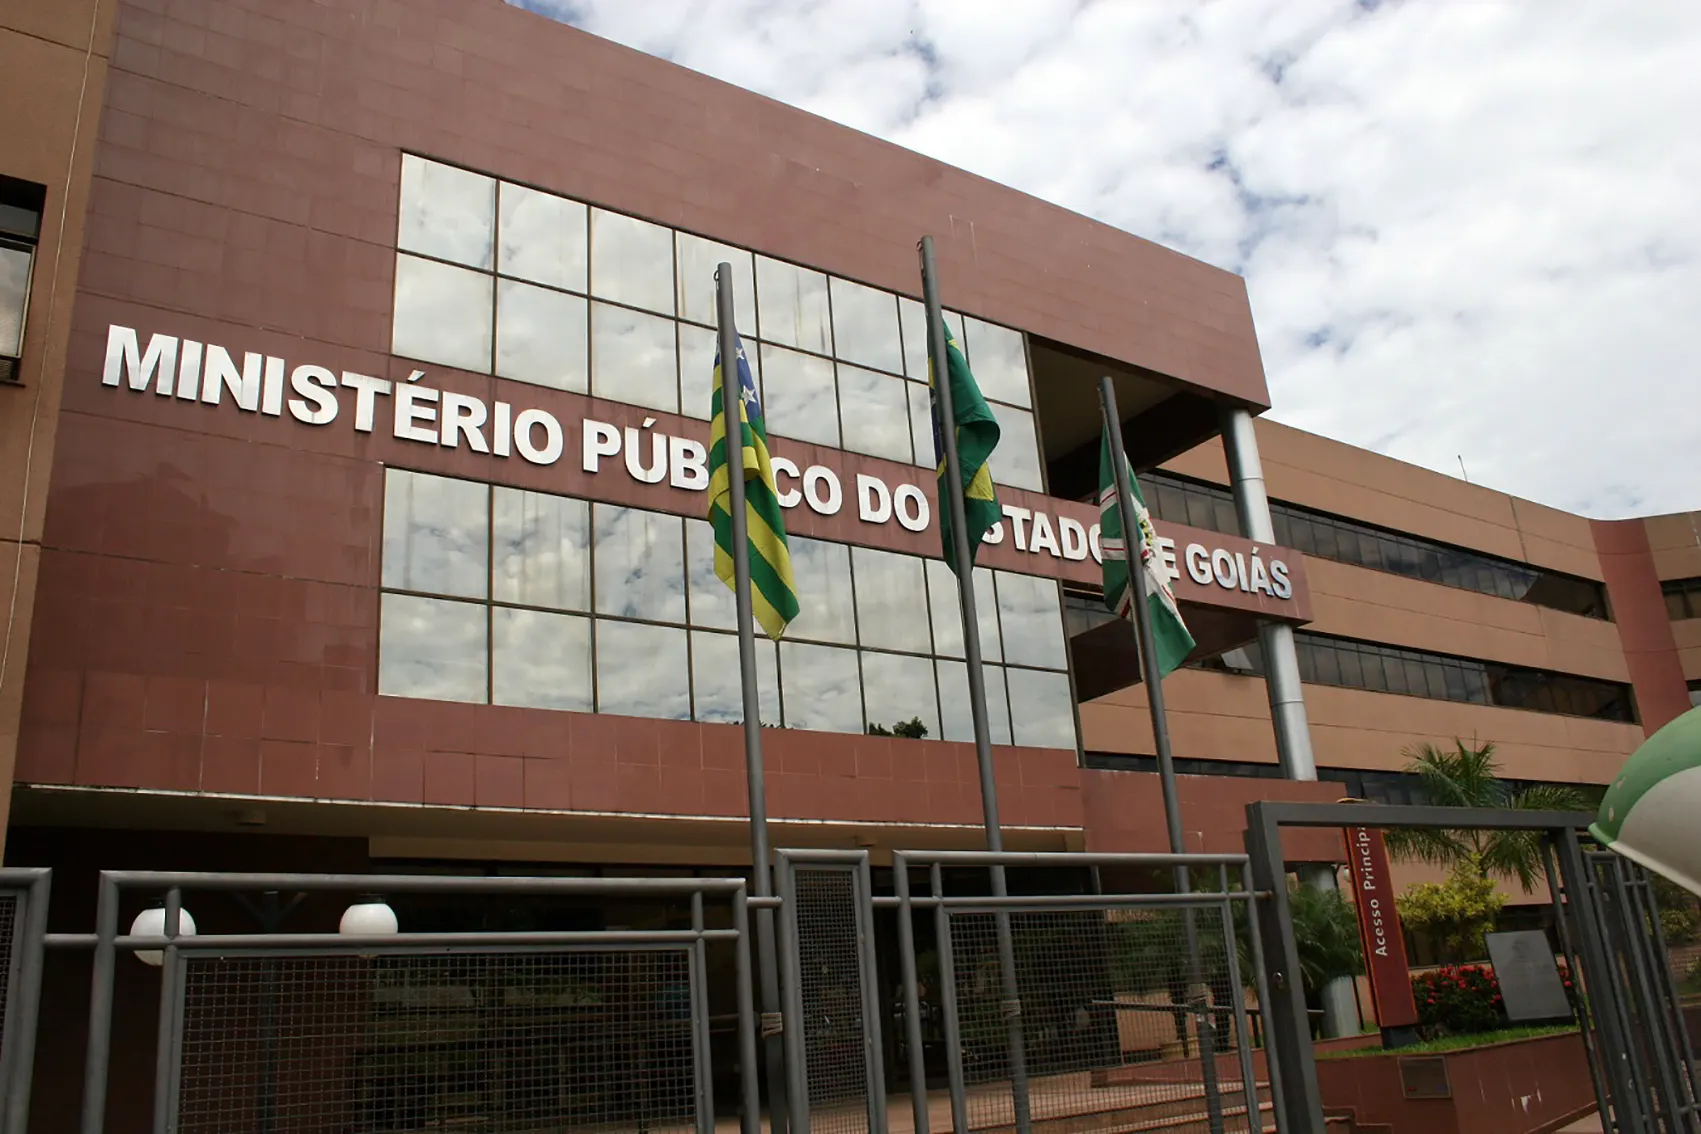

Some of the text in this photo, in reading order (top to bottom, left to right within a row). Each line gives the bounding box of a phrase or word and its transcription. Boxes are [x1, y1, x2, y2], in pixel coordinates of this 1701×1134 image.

[102, 324, 564, 465] MINISTÉRIO
[582, 417, 843, 515] PÚBCO
[856, 473, 930, 532] DO
[1185, 543, 1292, 599] GOIÁS
[1370, 899, 1388, 957] Acesso
